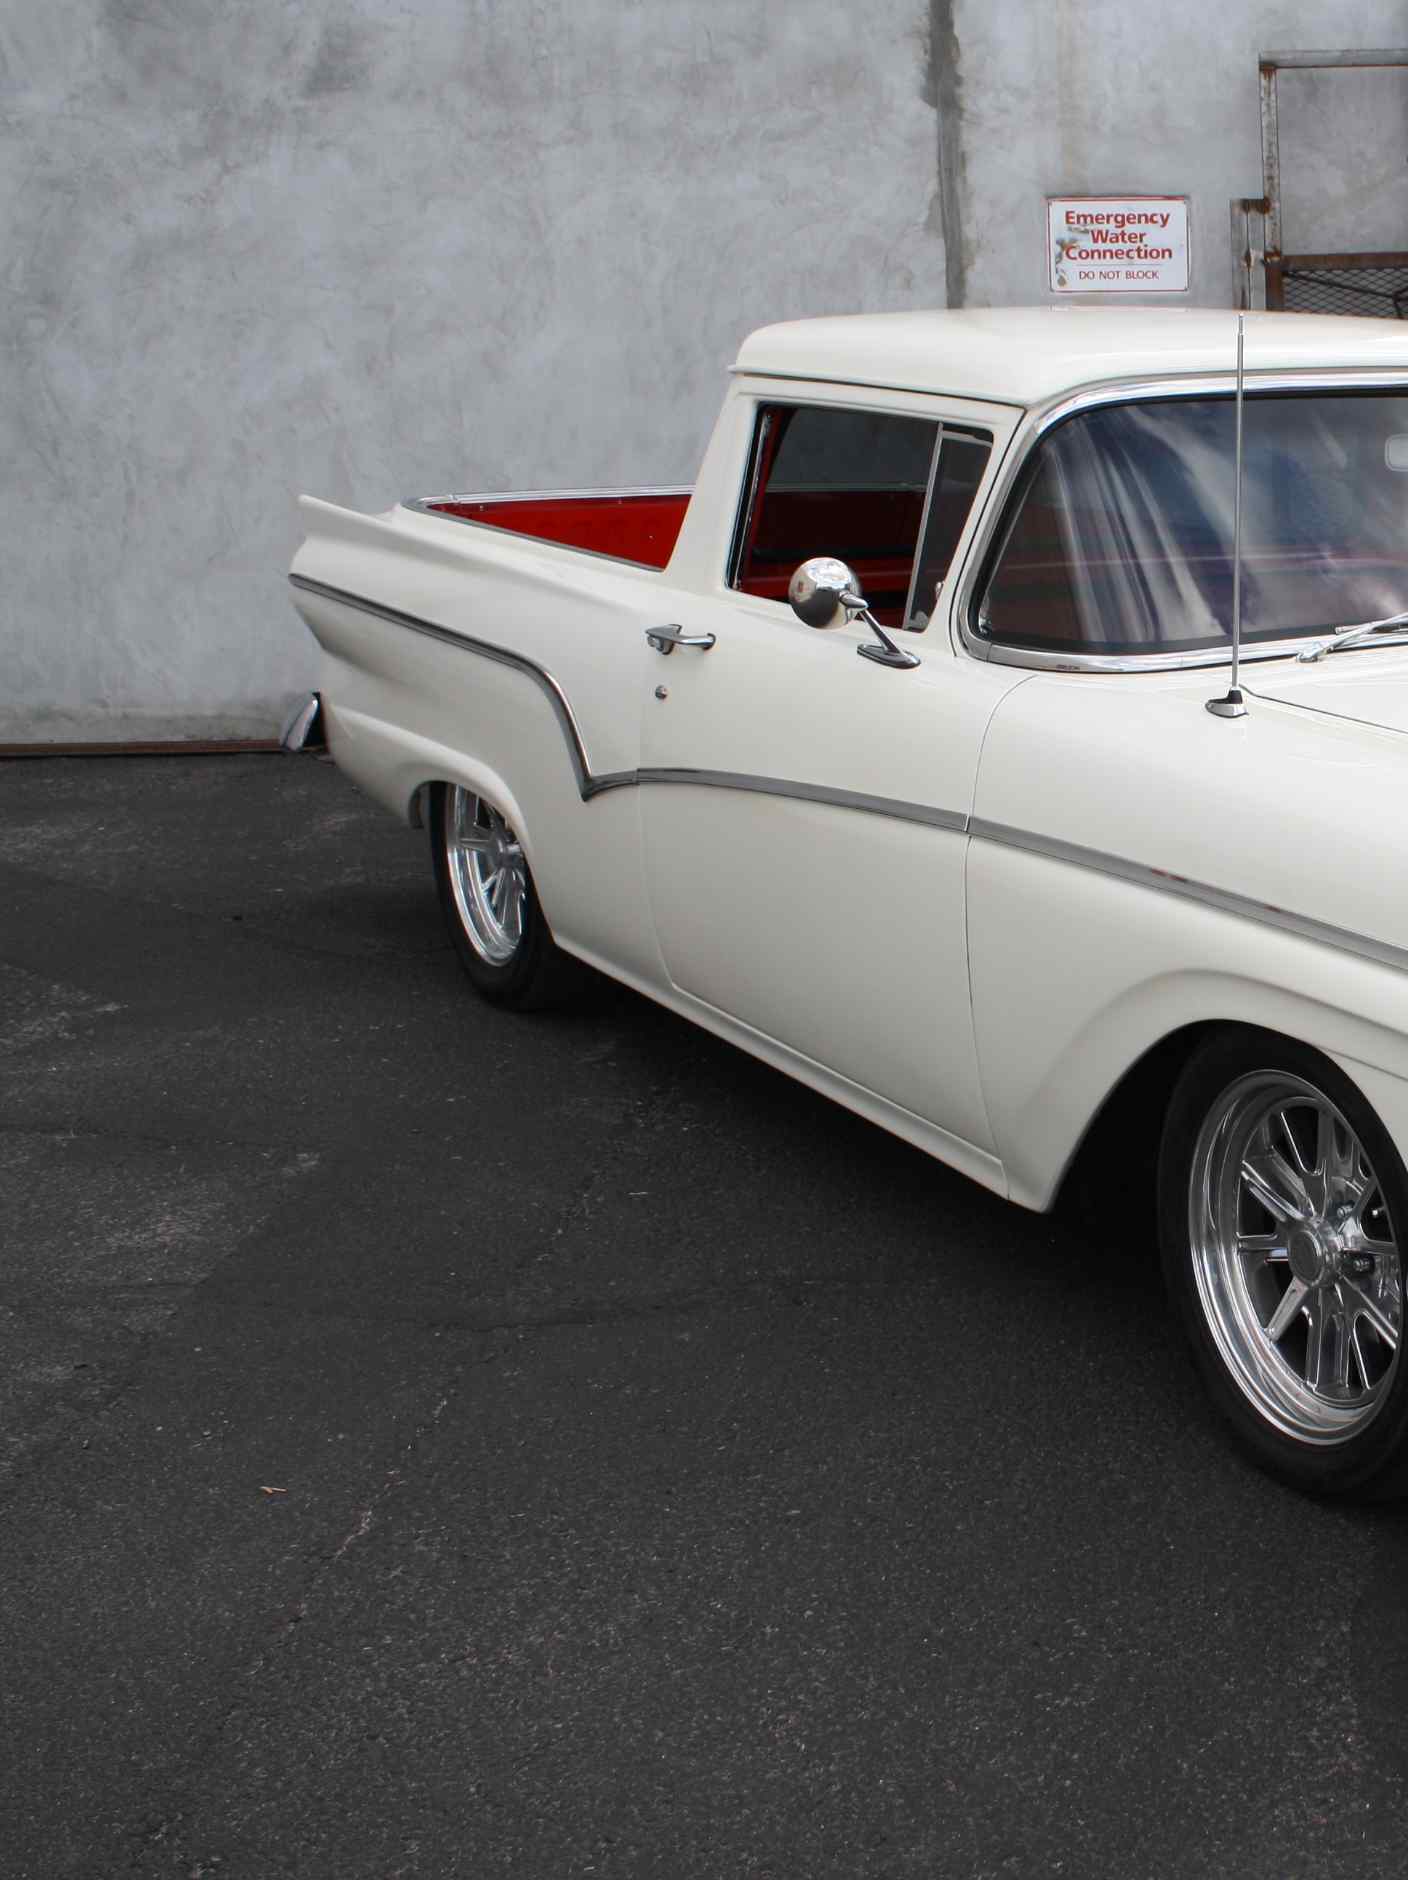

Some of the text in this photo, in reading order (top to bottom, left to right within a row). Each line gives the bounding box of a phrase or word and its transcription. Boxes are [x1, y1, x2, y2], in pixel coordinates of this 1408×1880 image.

[1065, 211, 1170, 228] Emergency
[1091, 230, 1147, 243] Water
[1065, 244, 1173, 260] Connection
[1079, 270, 1159, 280] DO NOT BLOCK
